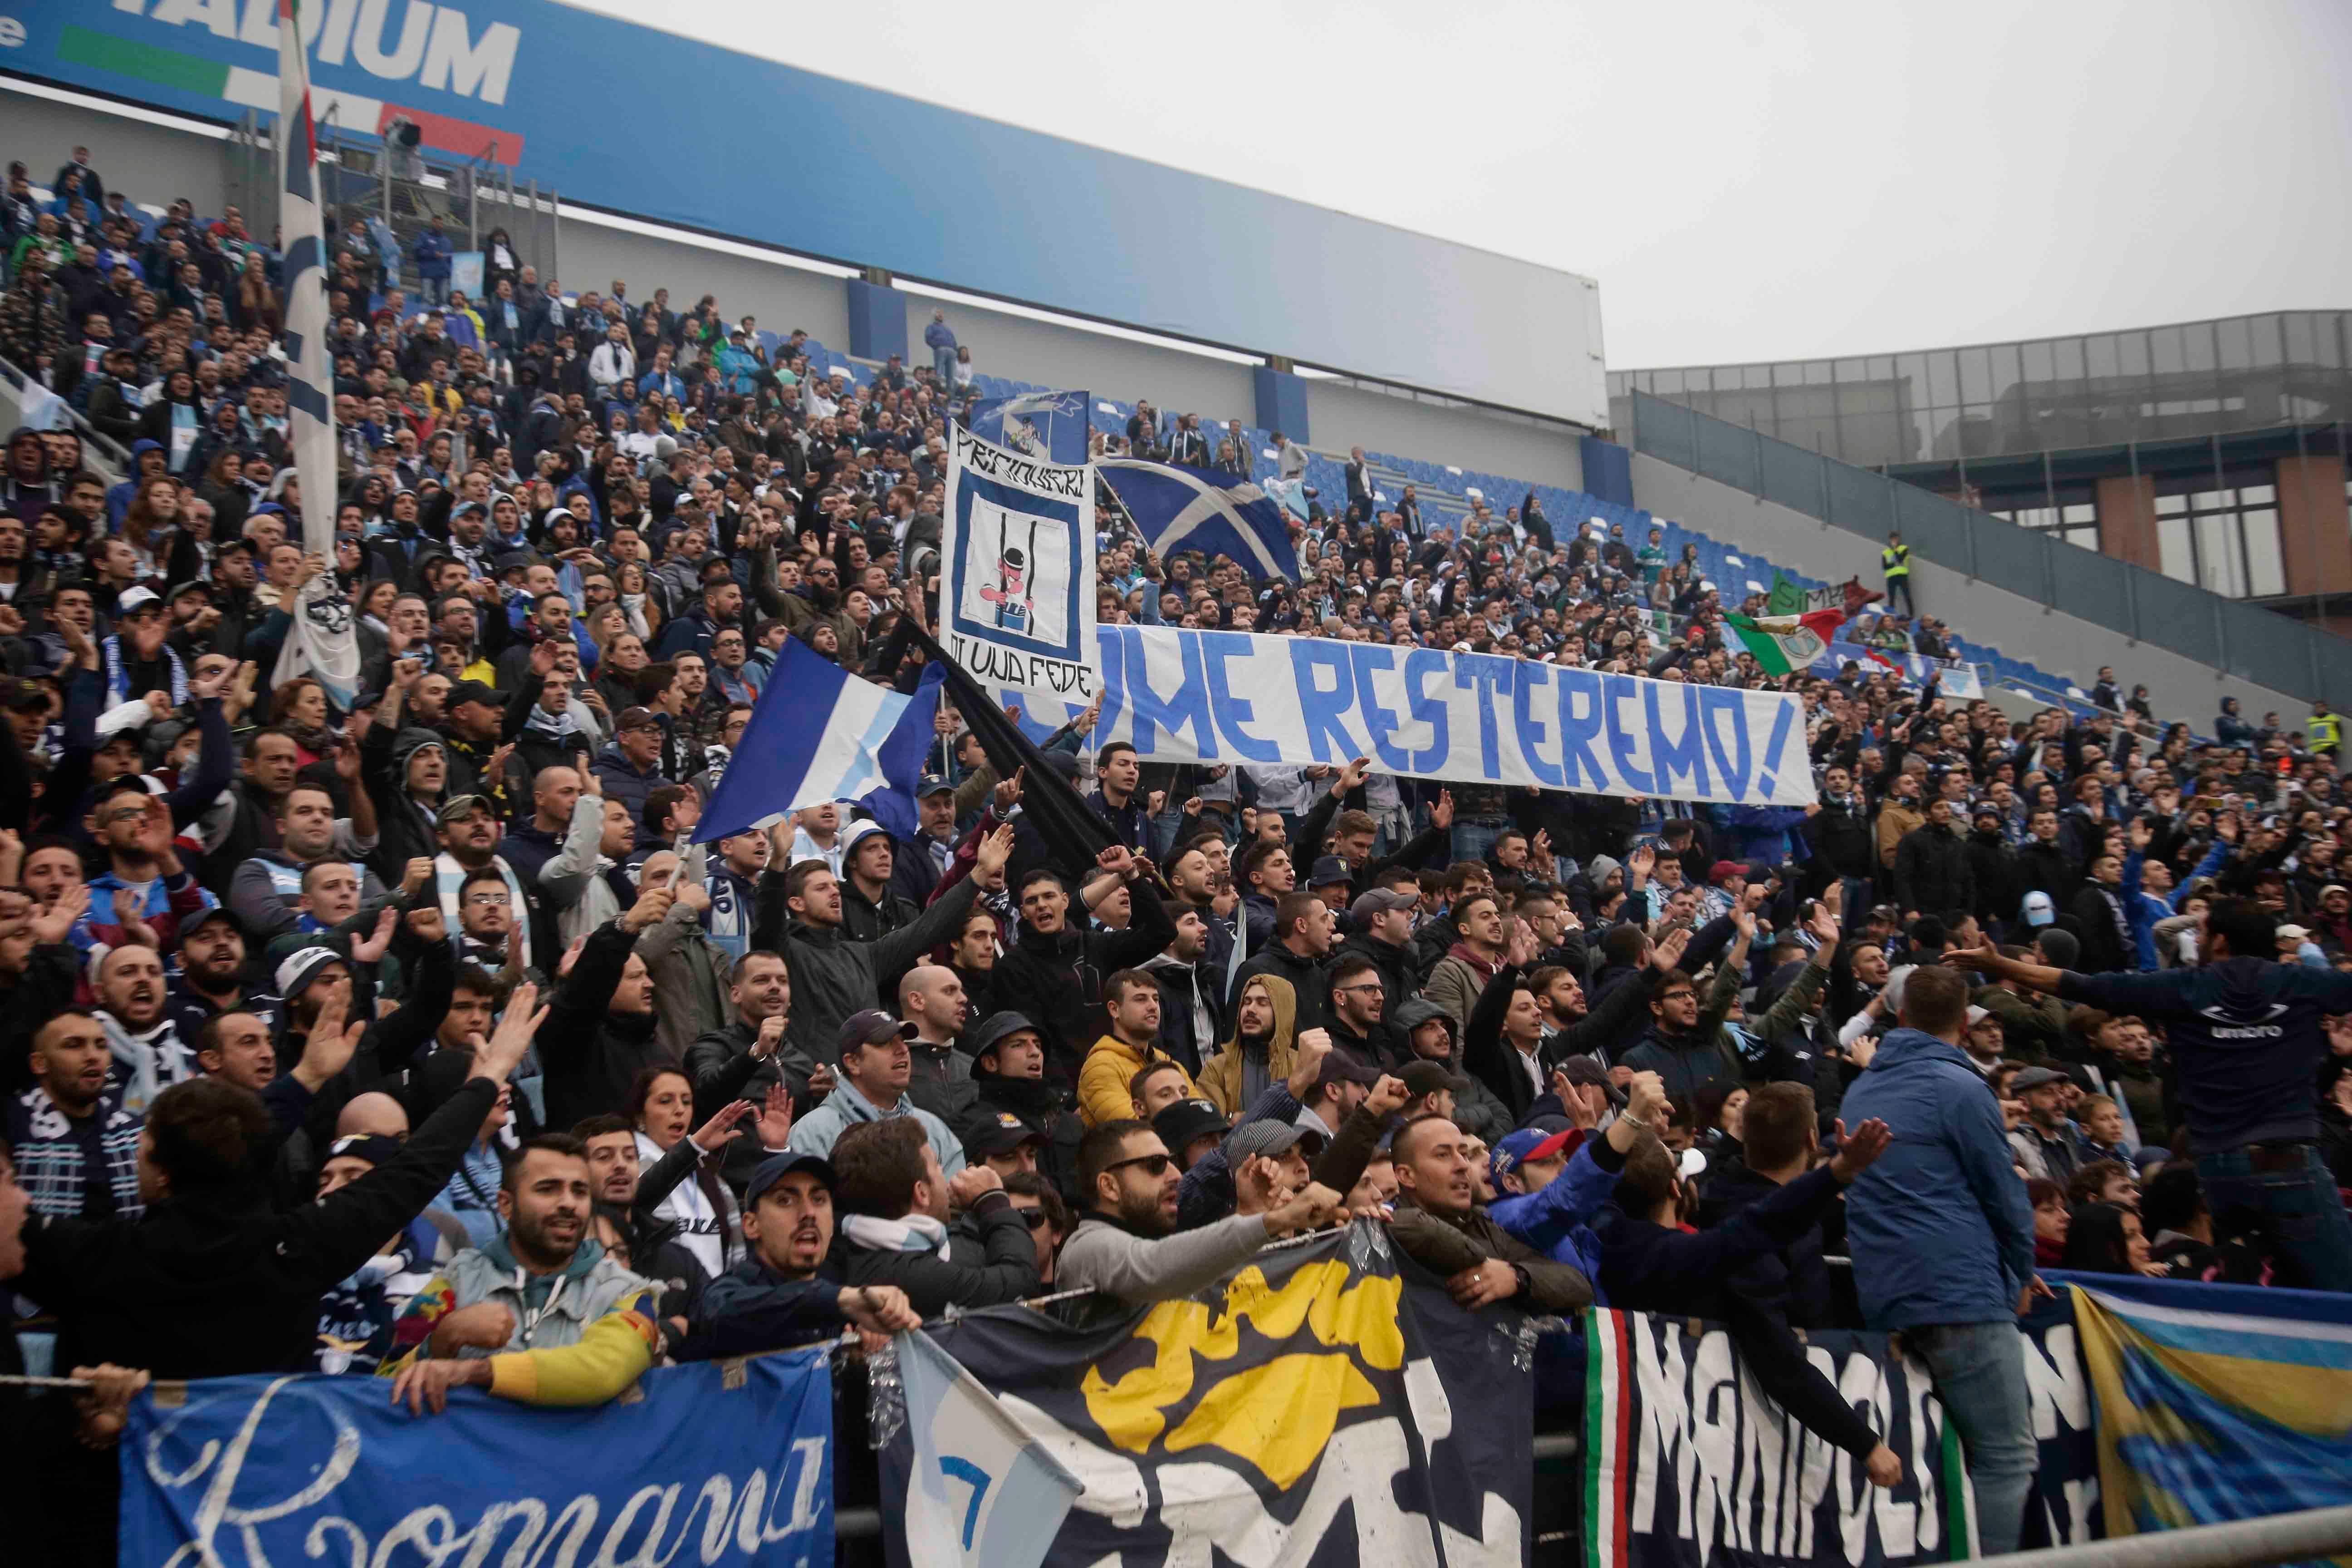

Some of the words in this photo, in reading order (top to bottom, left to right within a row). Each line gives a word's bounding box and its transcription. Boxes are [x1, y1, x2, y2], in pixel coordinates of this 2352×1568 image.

[970, 642, 1025, 686] UNA
[1030, 657, 1092, 698] FEDE
[1288, 638, 1794, 802] RESTEREMO!
